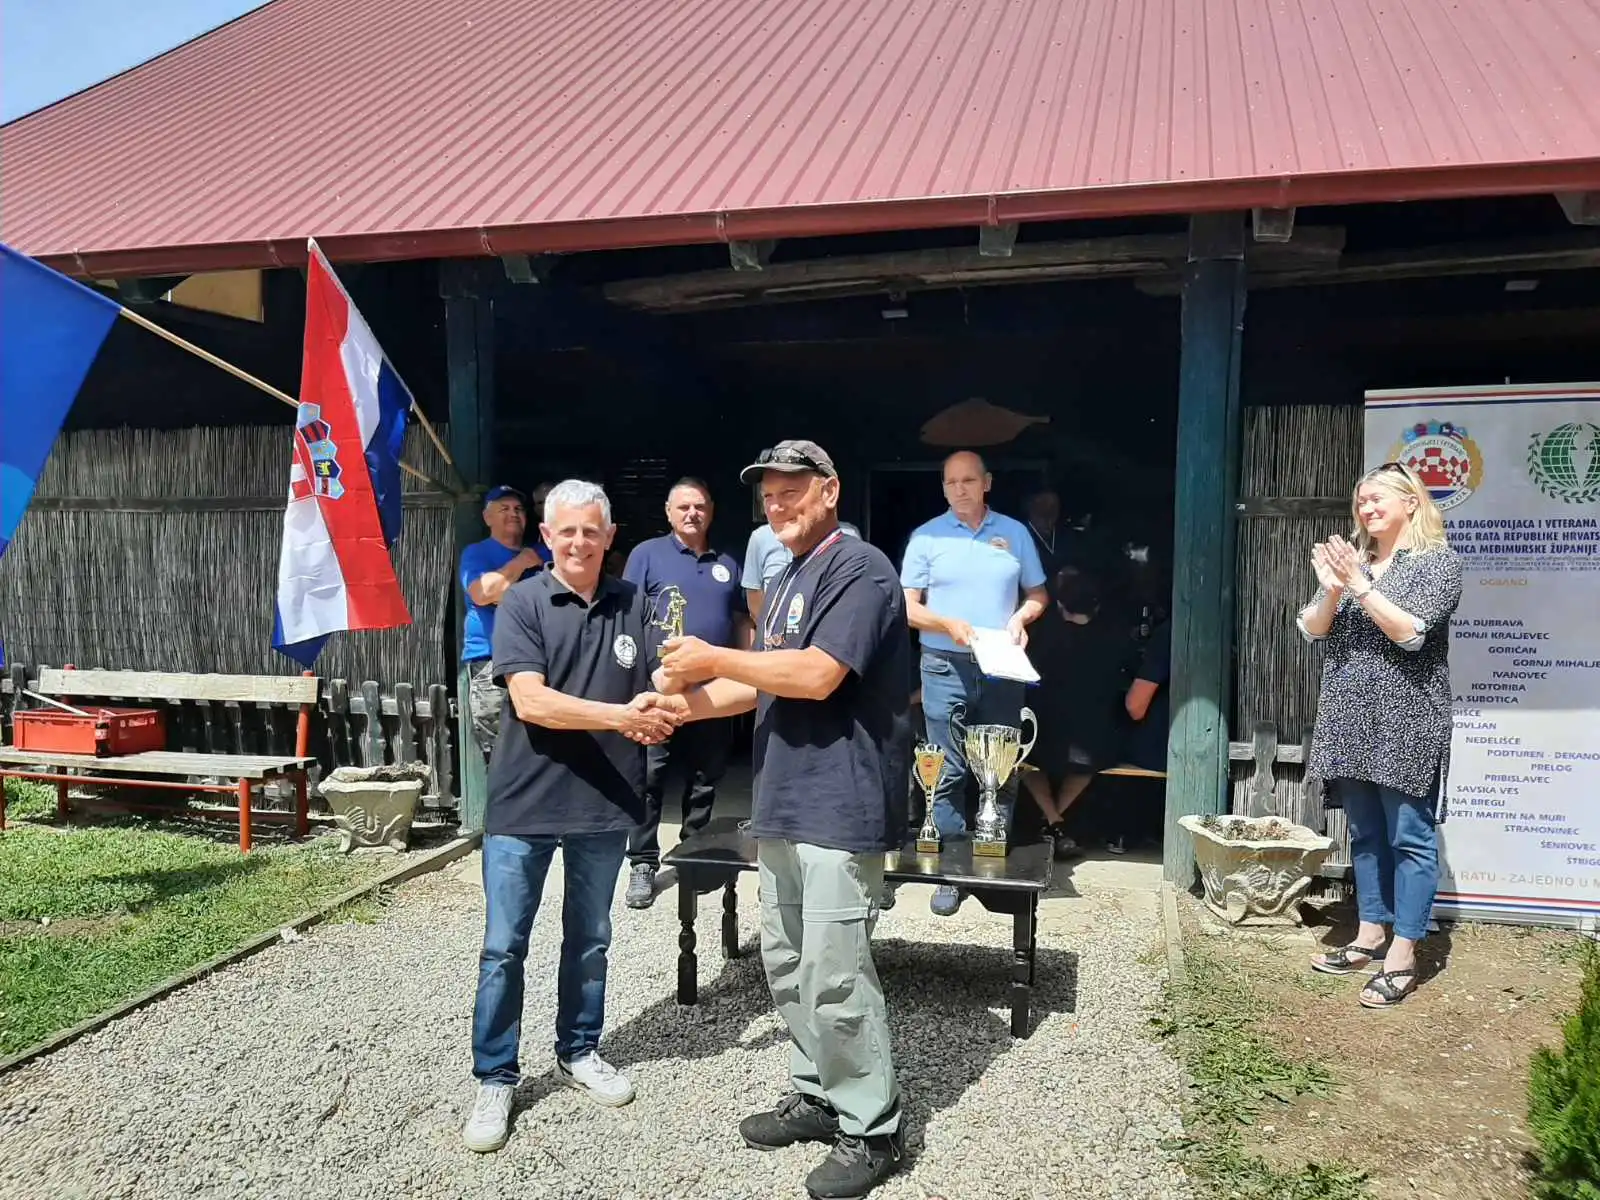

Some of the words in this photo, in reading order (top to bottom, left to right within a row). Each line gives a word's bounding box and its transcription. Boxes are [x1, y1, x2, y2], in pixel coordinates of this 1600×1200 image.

[1459, 519, 1535, 531] DRAGOVOLJACA
[1538, 519, 1542, 529] I
[1545, 518, 1597, 529] VETERANA
[1475, 531, 1501, 541] RATA
[1504, 531, 1559, 541] REPUBLIKE
[1562, 531, 1600, 541] HRVATS
[1550, 542, 1597, 556] ŽUPANIJE
[1473, 619, 1524, 627] DUBRAVA
[1455, 631, 1488, 640] DONJI
[1491, 631, 1550, 640] KRALJEVEC
[1513, 659, 1552, 668] GORNJI
[1555, 660, 1600, 669] MIHALJE
[1492, 671, 1548, 680] IVANOVEC
[1471, 682, 1526, 692] KOTORIBA
[1466, 695, 1519, 704] SUBOTICA
[1487, 749, 1544, 759] PODTUREN
[1554, 751, 1600, 761] DEKANO
[1531, 763, 1573, 772] PRELOG
[1484, 774, 1551, 784] PRIBISLAVEC
[1456, 785, 1496, 794] SAVSKA
[1500, 787, 1520, 795] VES
[1471, 798, 1505, 807] BREGU
[1476, 811, 1517, 820] MARTIN
[1520, 813, 1536, 821] NA
[1539, 814, 1566, 822] MURI
[1504, 824, 1580, 835] STRAHONINEC
[1460, 870, 1496, 882] RATU
[1509, 873, 1575, 888] ZAJEDNO
[1579, 877, 1589, 888] U
